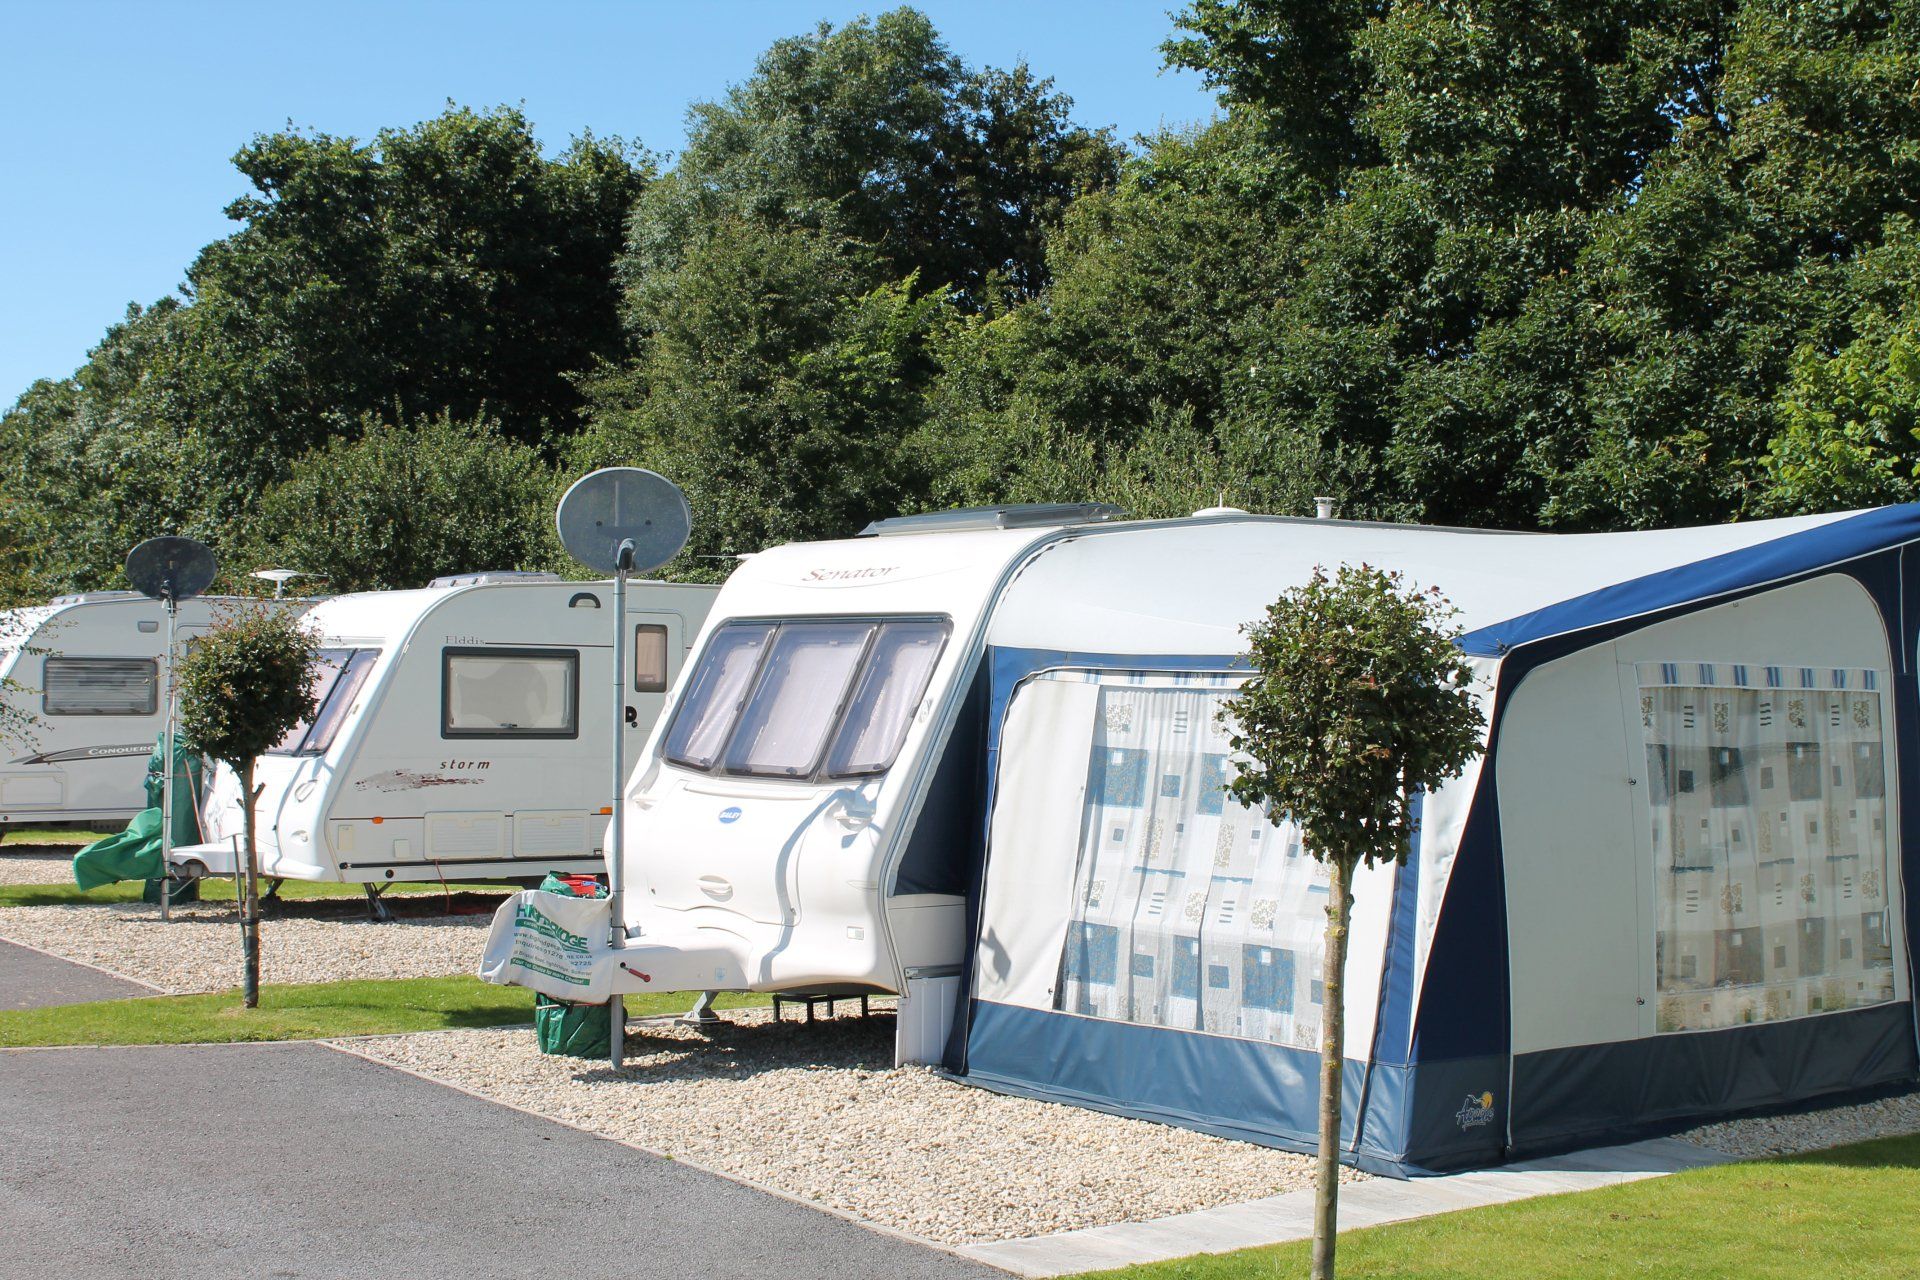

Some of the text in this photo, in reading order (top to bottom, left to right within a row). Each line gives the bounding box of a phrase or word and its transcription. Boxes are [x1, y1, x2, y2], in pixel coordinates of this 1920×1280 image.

[801, 566, 901, 581] Senator
[444, 635, 485, 645] Elddis
[88, 745, 157, 756] CONQUERO
[440, 758, 490, 770] storm
